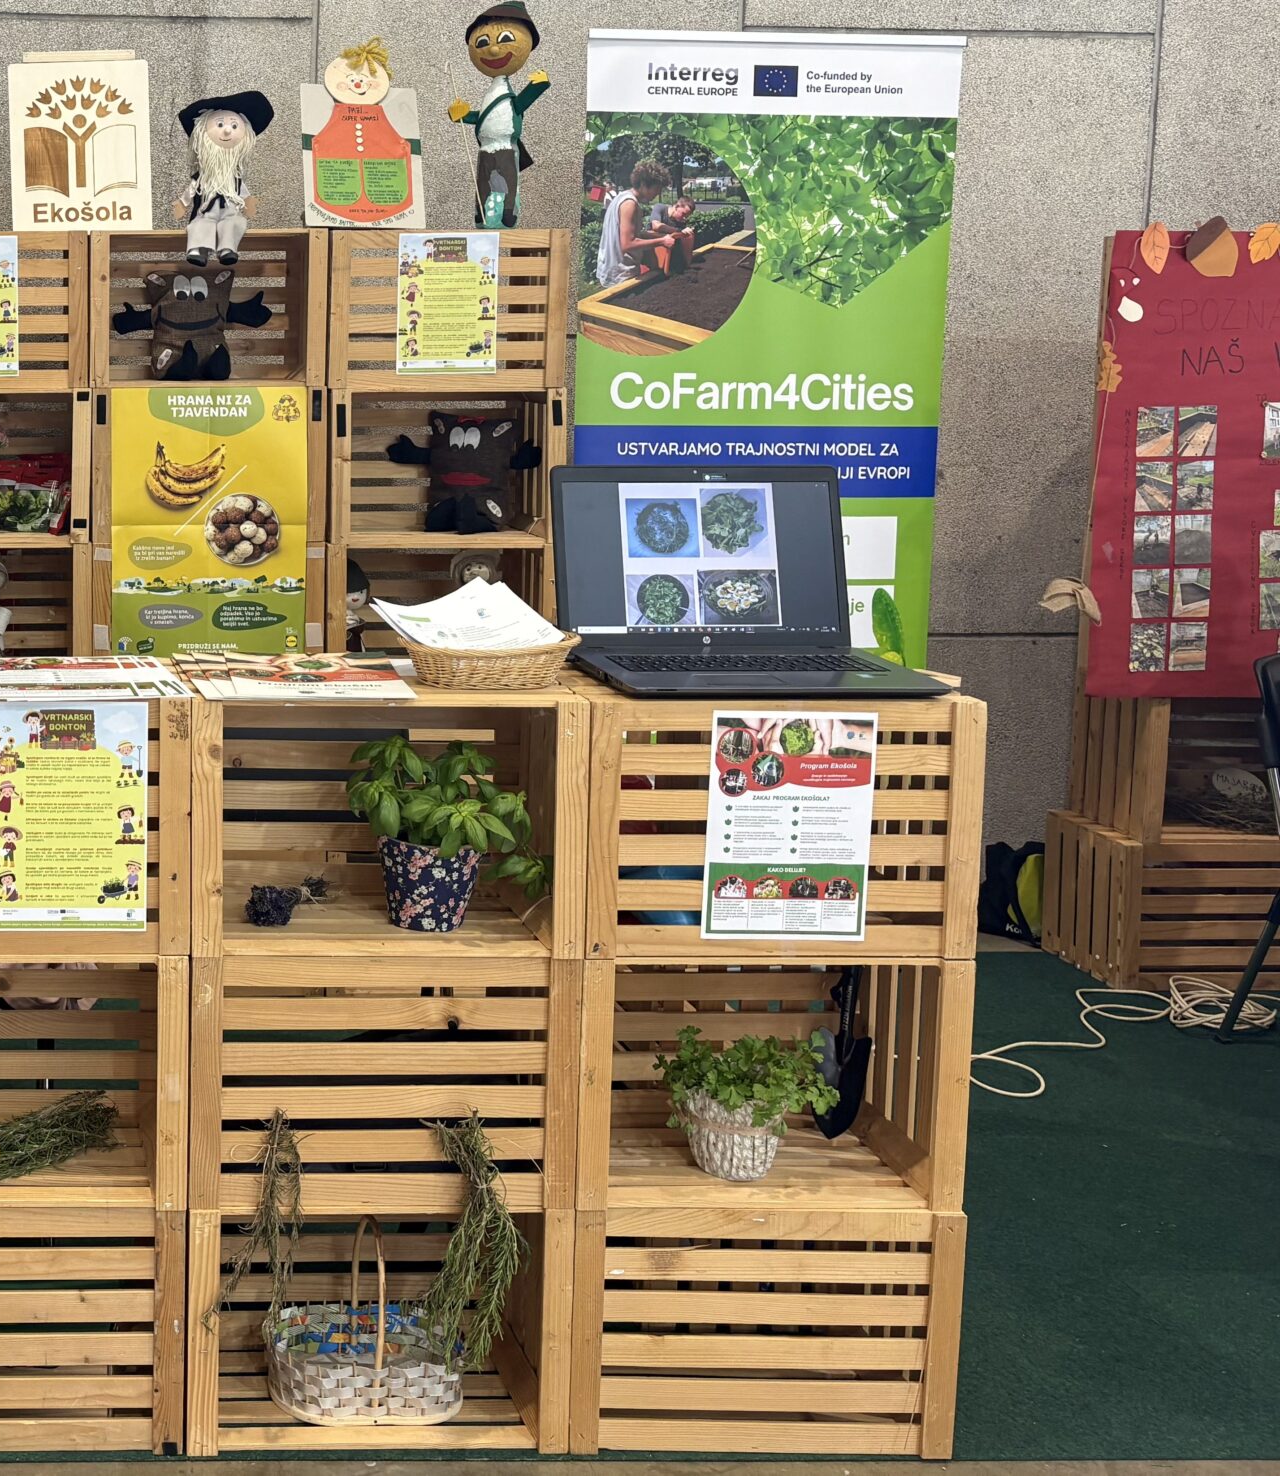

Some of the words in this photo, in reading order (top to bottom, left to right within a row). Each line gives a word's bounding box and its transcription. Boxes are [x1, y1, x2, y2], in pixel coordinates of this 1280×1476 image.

[647, 62, 739, 85] Interreg
[806, 70, 858, 82] Co-funded
[860, 71, 873, 83] by
[647, 87, 695, 96] CENTRAL
[697, 87, 738, 97] EUROPE
[806, 83, 822, 94] the
[823, 84, 872, 95] European
[874, 84, 903, 95] Union
[33, 201, 132, 223] Ekošola
[1181, 337, 1245, 376] NAŠ
[610, 372, 913, 411] CoFarm4Cities
[167, 395, 214, 406] HRANA
[216, 395, 232, 405] NI
[234, 394, 252, 405] ZA
[171, 406, 248, 418] TJAVENDAN
[617, 441, 722, 456] USTVARJAMO
[726, 442, 820, 457] TRAJNOSTNI
[823, 443, 876, 457] MODEL
[880, 443, 899, 457] ZA
[858, 465, 911, 480] EVROPI
[44, 713, 92, 722] VRTNARSKI
[49, 723, 87, 731] BONTON
